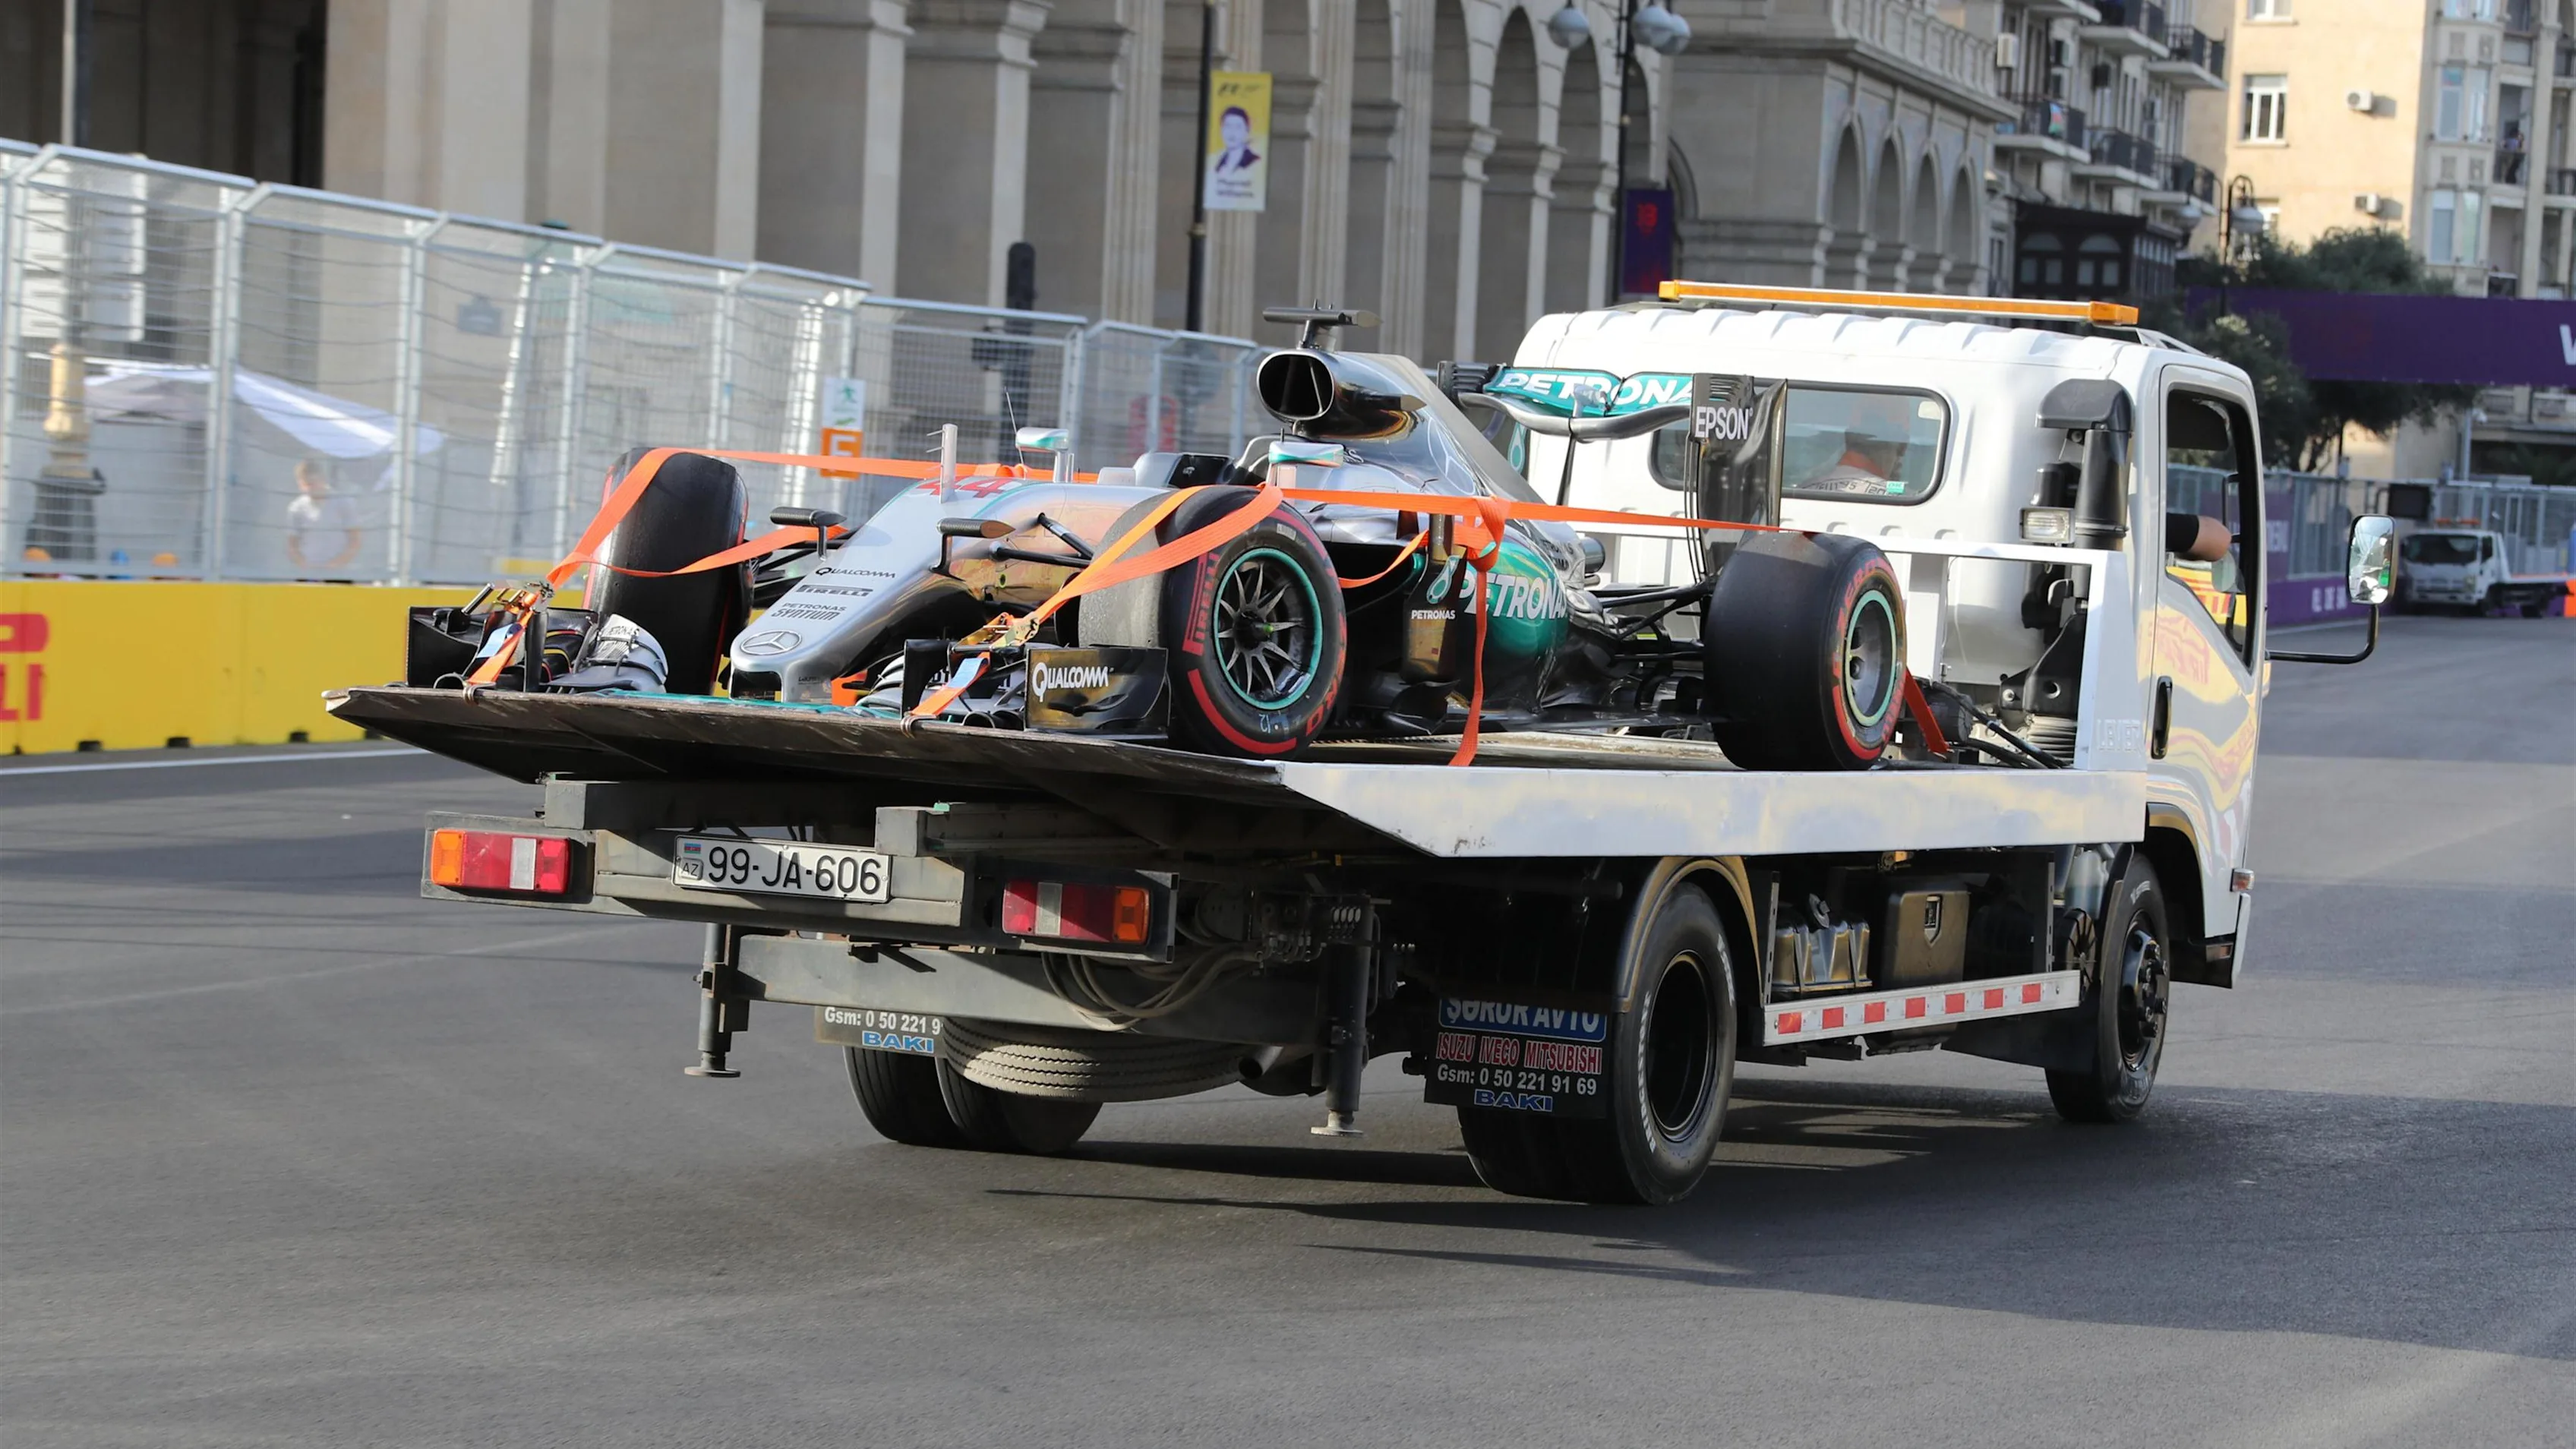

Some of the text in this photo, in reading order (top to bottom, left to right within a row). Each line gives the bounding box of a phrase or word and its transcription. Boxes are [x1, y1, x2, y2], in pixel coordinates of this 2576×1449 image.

[1496, 374, 1693, 406] PETRONA
[1694, 406, 1750, 440] EPSON
[815, 567, 896, 579] QUALCOMM
[796, 584, 874, 598] PIRELLI
[771, 608, 841, 621] SYNTIUM
[782, 602, 847, 611] PETRONAS
[1411, 609, 1457, 621] PETRONAS
[1031, 661, 1110, 703] QUALCOMM
[681, 846, 882, 895] AZ 99-JA-606
[824, 1006, 944, 1036] Gsm: 0 50 221 9
[862, 1030, 935, 1054] BAKI
[1436, 1031, 1603, 1075] ISUZU IVECO MITSUBISHI
[1437, 1064, 1597, 1096] Gsm: 0 50 221 91 69
[1473, 1088, 1554, 1113] BAKI
